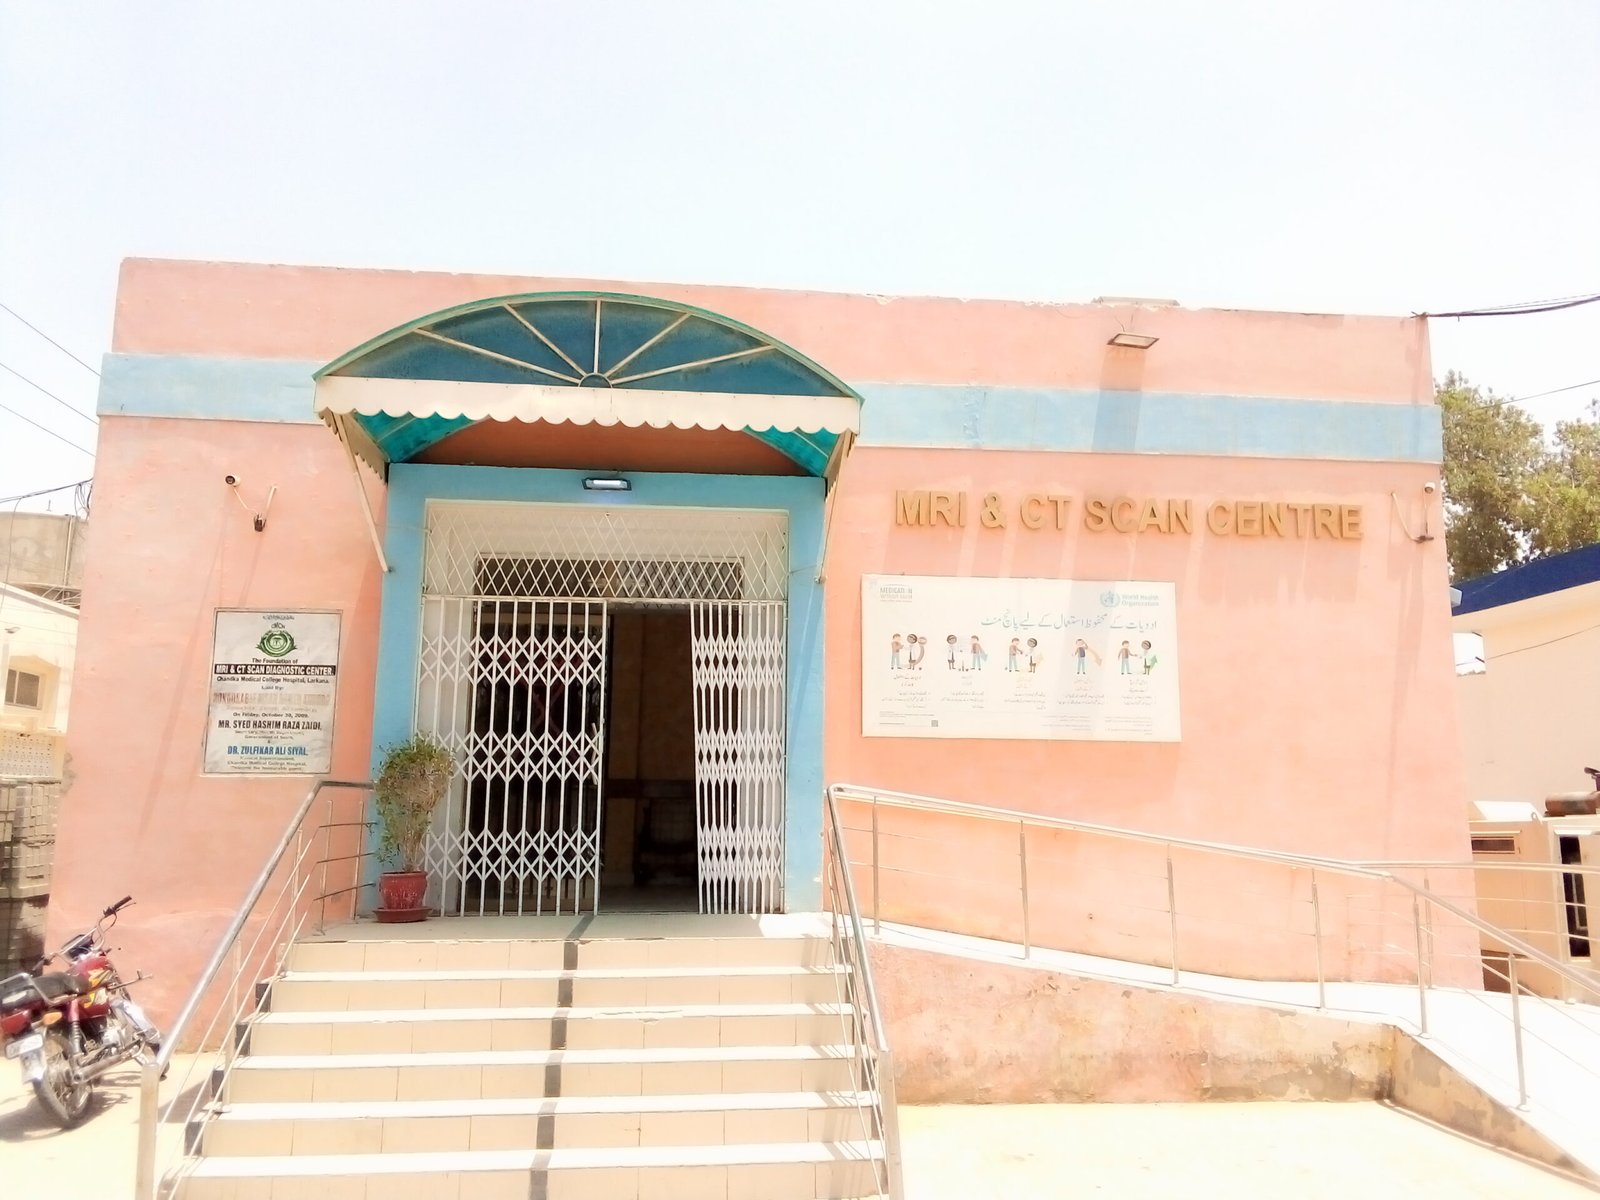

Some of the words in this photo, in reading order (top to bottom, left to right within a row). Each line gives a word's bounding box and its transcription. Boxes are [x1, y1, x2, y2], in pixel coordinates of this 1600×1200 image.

[894, 489, 966, 528] MRI
[980, 492, 1006, 529] &
[1019, 494, 1073, 531] CT
[1083, 497, 1194, 534] SCAN
[1205, 500, 1364, 539] CENTRE
[216, 664, 229, 674] MRI
[229, 665, 236, 674] &
[236, 665, 246, 674] CT
[247, 665, 265, 674] SCAN
[265, 665, 305, 675] DIAGNOSTIC
[261, 676, 282, 684] College
[218, 720, 231, 729] MR.
[233, 720, 251, 729] SYED
[252, 720, 281, 729] HASHIM
[282, 721, 300, 730] RAZA
[227, 745, 240, 755] DR.
[240, 745, 274, 755] ZULFIKAR
[275, 746, 286, 755] ALI
